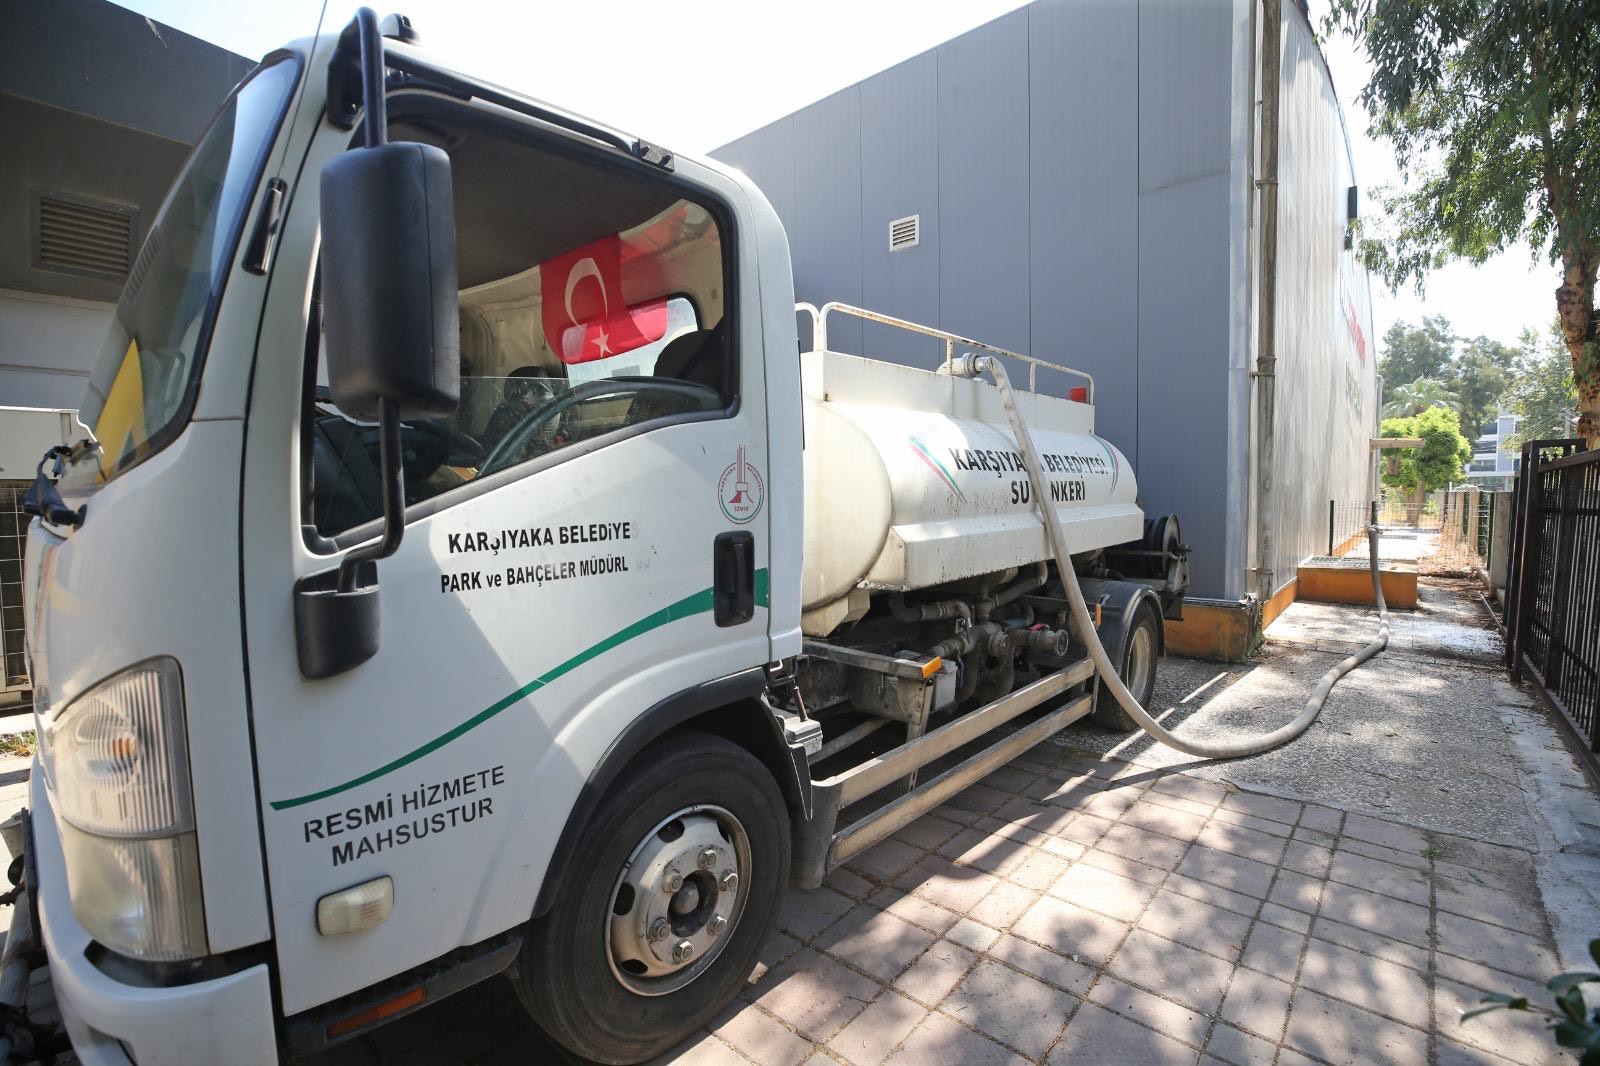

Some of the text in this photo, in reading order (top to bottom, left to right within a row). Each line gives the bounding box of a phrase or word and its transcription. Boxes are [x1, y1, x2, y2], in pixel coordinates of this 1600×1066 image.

[949, 448, 1045, 478] KARŞIYA
[1011, 480, 1030, 505] SU
[441, 570, 482, 593] PARK
[486, 571, 502, 588] ve
[506, 560, 576, 587] BAHÇELER
[304, 765, 505, 843] RESMİ HİZMETE
[332, 797, 494, 867] MAHSUSTUR
